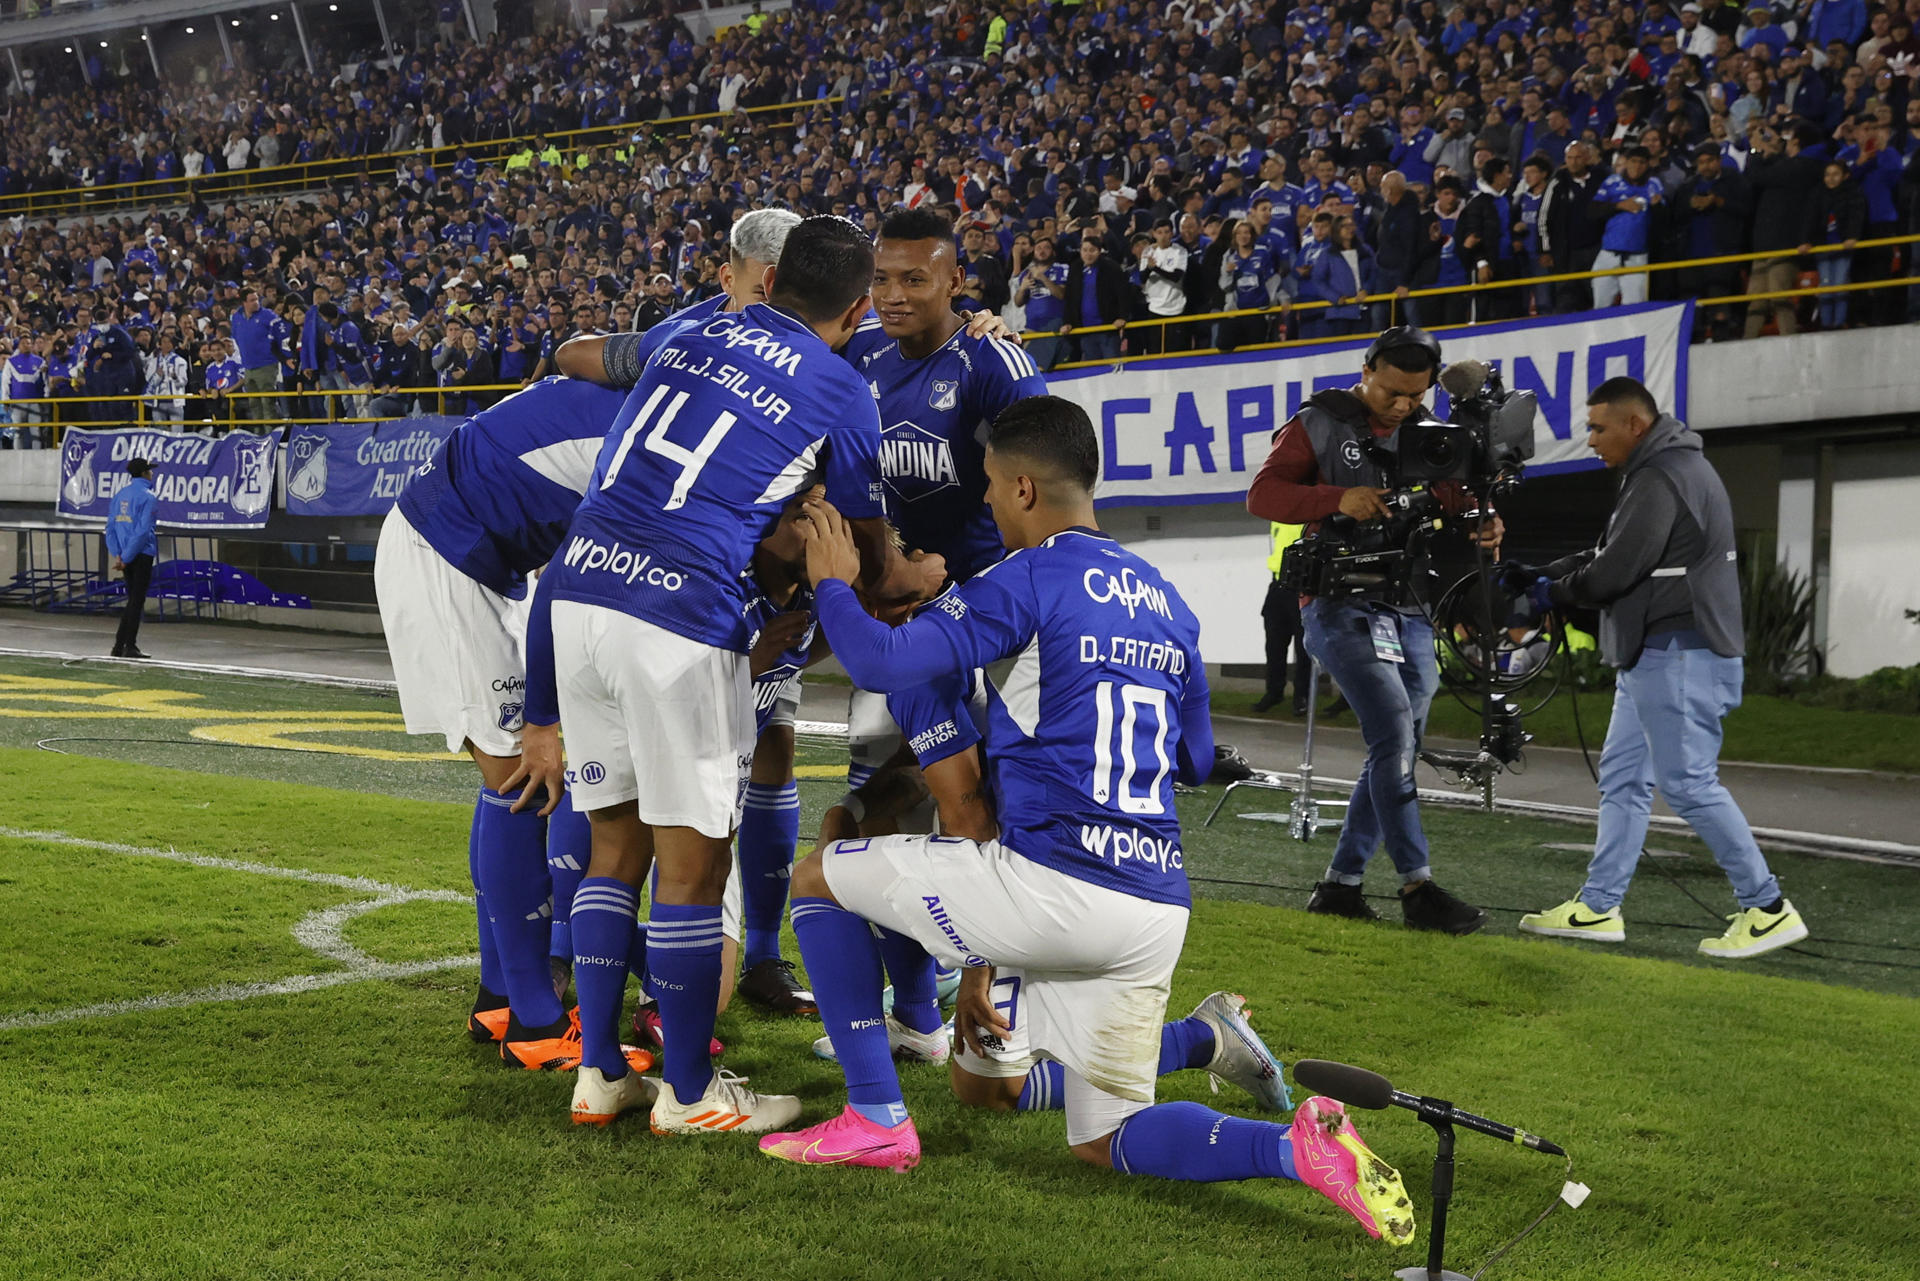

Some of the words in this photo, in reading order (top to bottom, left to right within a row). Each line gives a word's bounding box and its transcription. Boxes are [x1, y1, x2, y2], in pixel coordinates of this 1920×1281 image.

[111, 434, 217, 466] DINASTIA
[599, 383, 738, 511] 14
[563, 535, 684, 592] Wplay.co
[1092, 681, 1169, 815] 10
[1080, 824, 1183, 874] Wplay.c
[921, 895, 971, 954] Allianz
